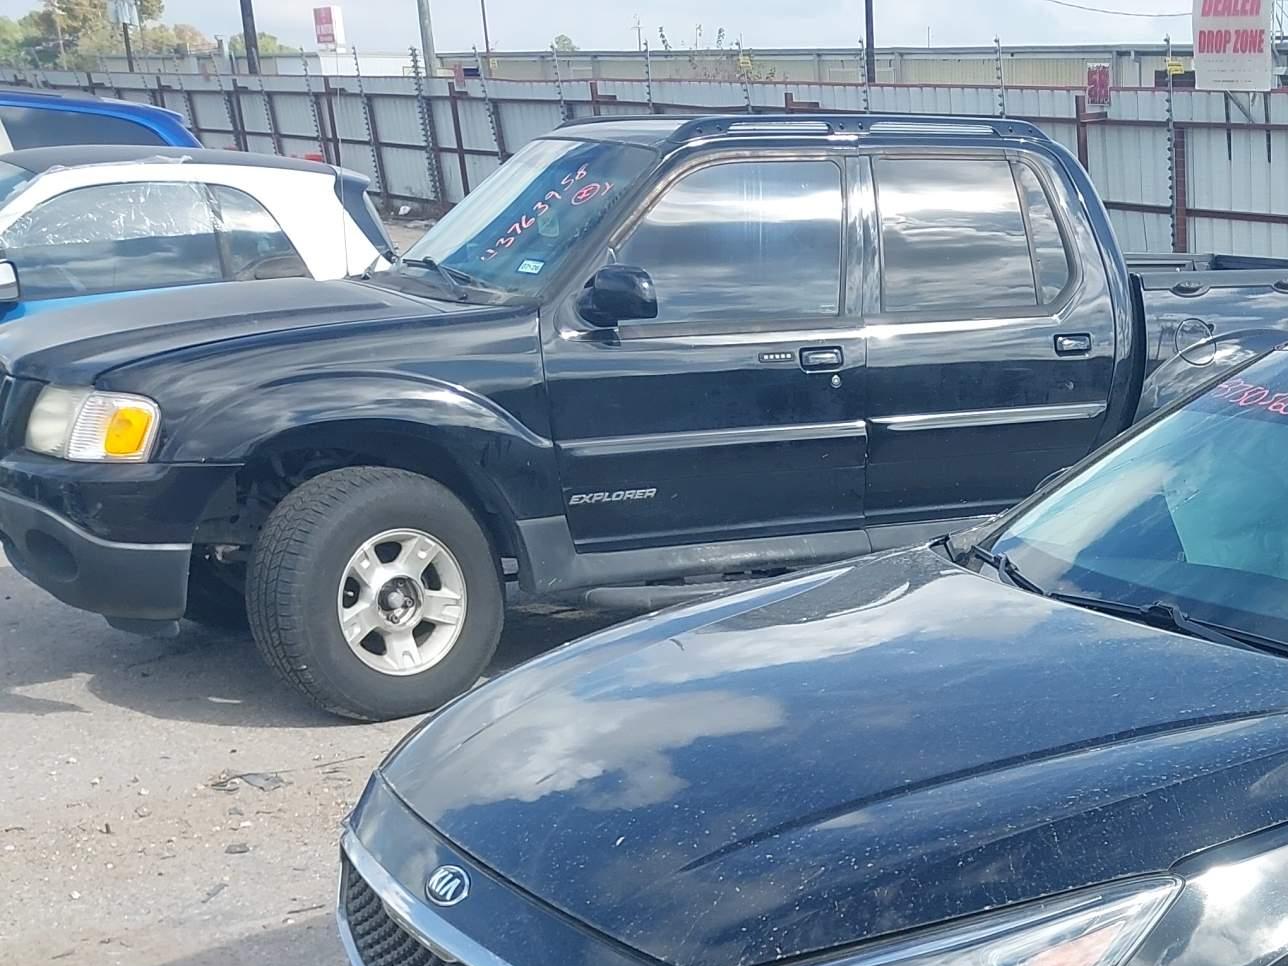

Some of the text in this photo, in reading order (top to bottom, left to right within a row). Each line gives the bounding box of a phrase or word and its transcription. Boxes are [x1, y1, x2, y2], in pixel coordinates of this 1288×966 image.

[1198, 29, 1265, 54] DROP ZONE
[568, 487, 657, 505] EXPLORER
[428, 868, 461, 901] KIA
